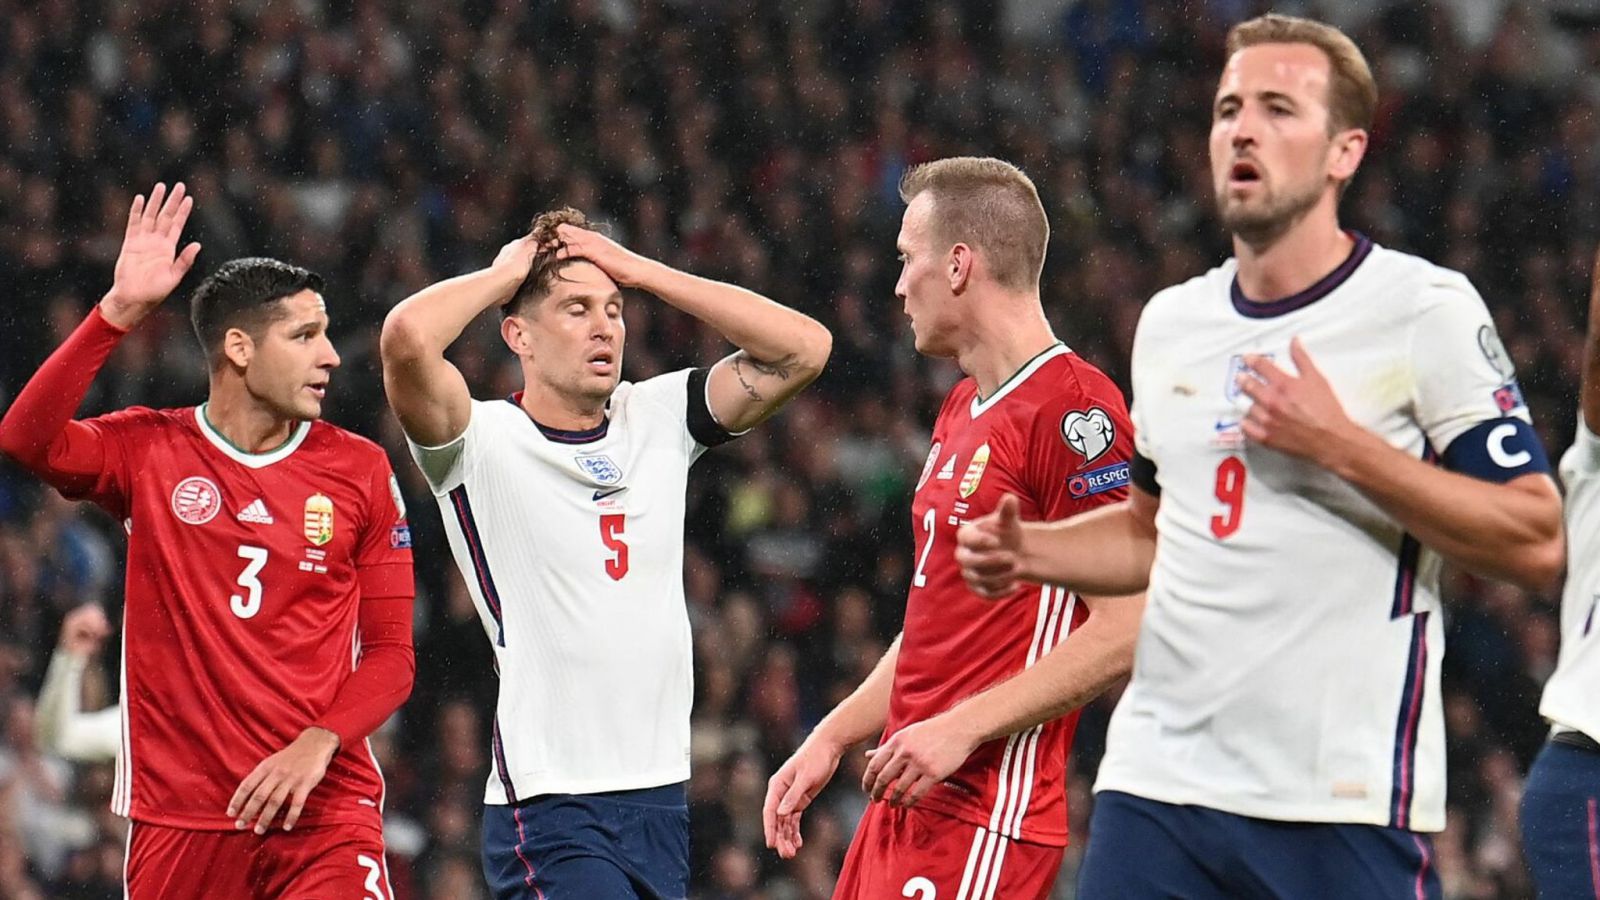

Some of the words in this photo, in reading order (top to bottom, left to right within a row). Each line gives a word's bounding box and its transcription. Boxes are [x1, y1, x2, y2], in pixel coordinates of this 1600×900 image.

[1088, 467, 1130, 488] RESPECT
[1486, 423, 1532, 468] C
[1210, 456, 1246, 539] 9
[599, 514, 629, 581] 5
[914, 508, 935, 588] 2
[229, 544, 269, 619] 3
[357, 854, 385, 900] 3
